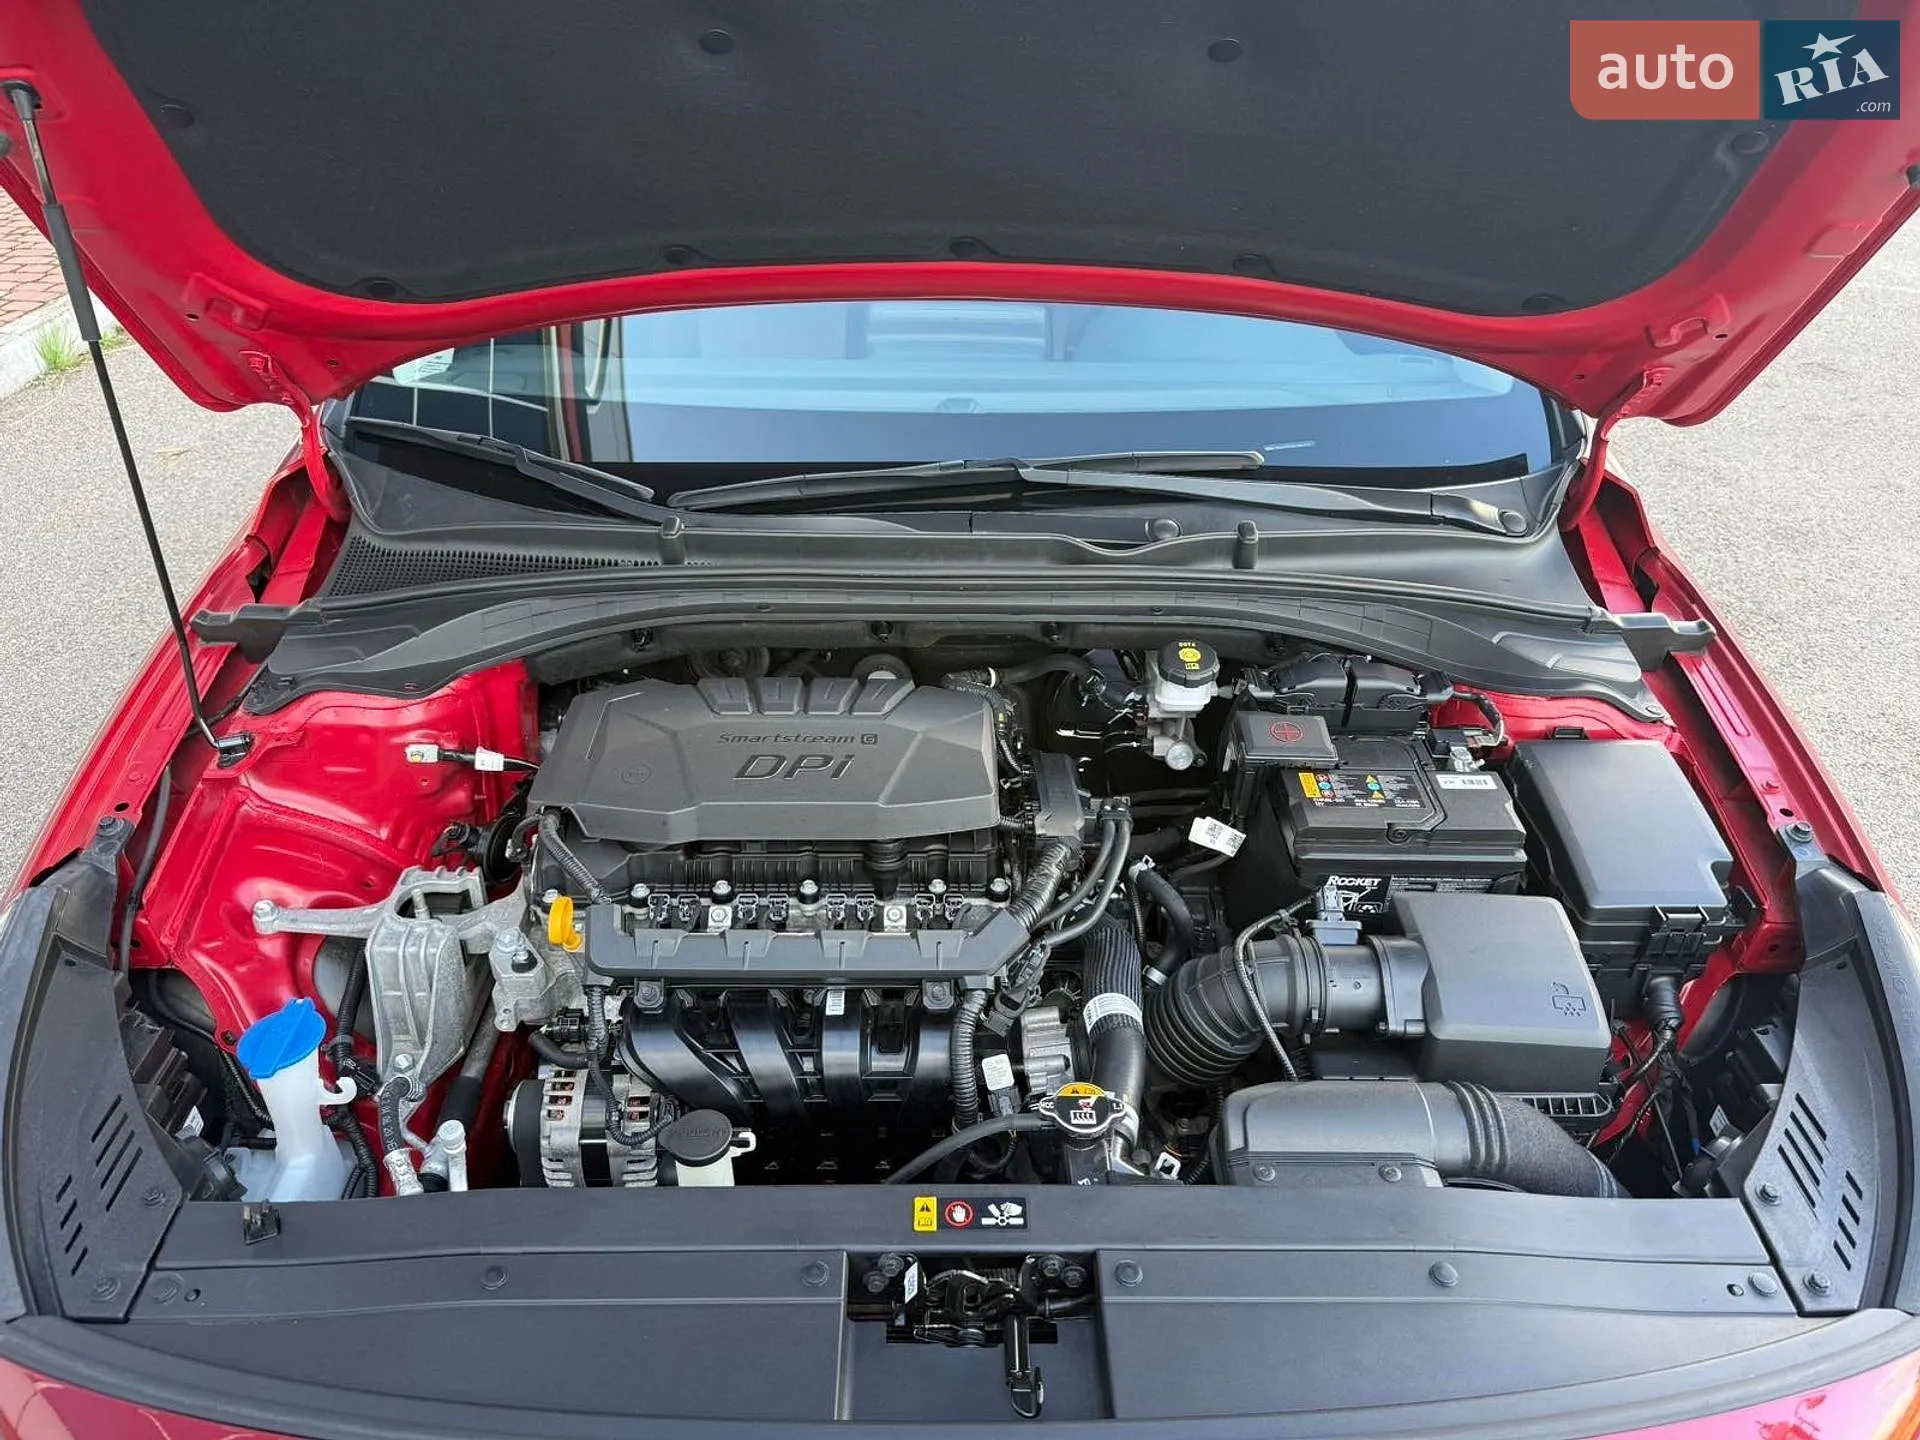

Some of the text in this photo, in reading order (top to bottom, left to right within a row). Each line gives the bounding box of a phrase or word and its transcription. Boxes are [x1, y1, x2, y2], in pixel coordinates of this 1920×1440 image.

[717, 733, 855, 744] Smartstream
[730, 754, 855, 781] DPi
[1327, 875, 1382, 886] ROCKET
